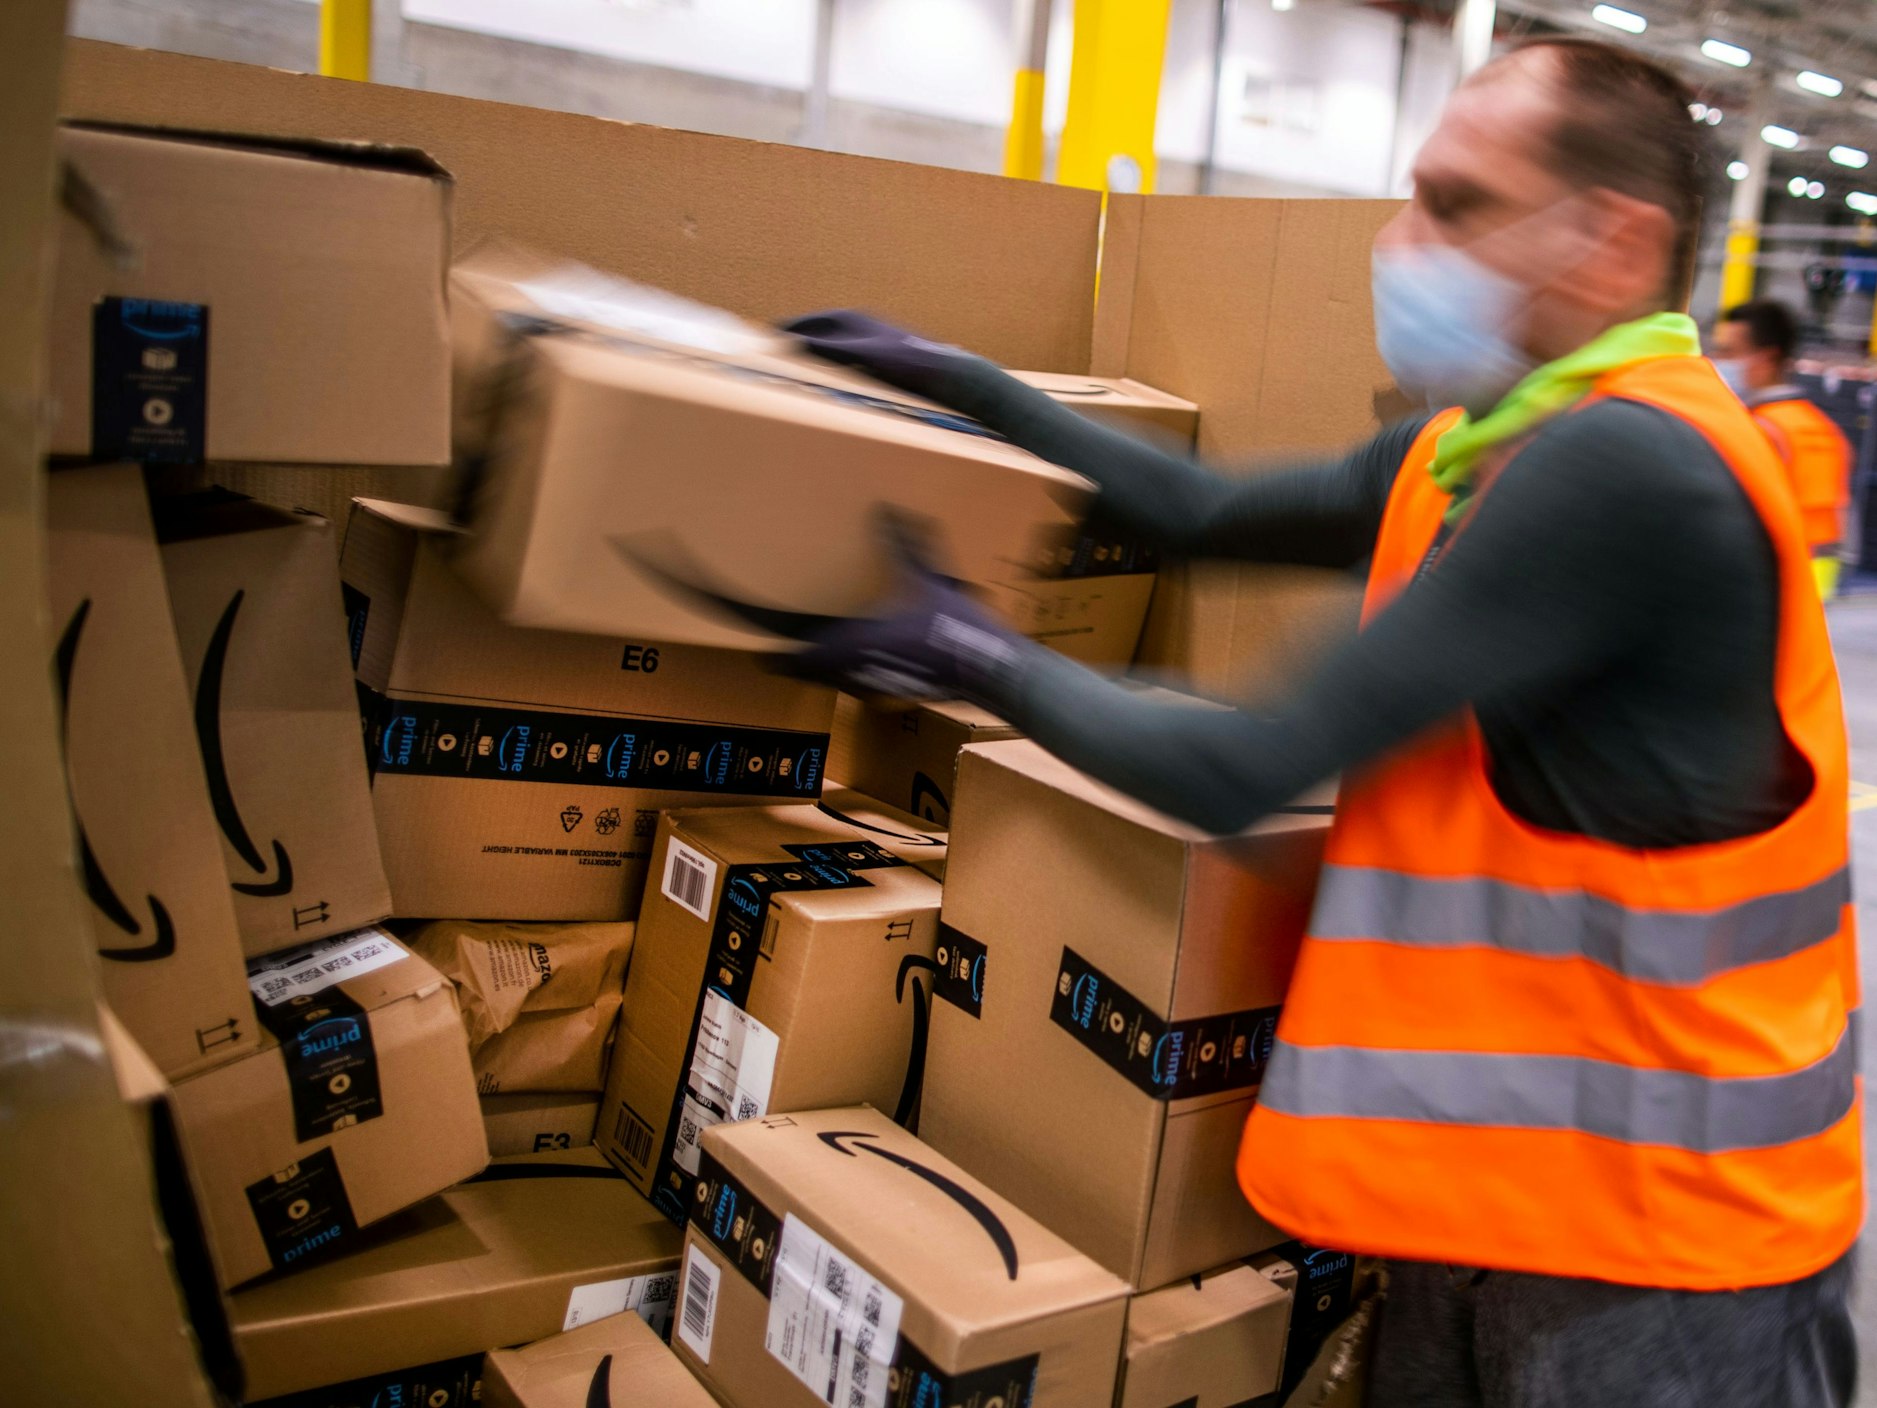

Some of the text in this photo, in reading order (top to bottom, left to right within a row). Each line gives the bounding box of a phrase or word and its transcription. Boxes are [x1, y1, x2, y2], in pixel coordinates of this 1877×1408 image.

[621, 645, 660, 673] E6
[397, 716, 418, 765] prime
[511, 725, 531, 772] prime
[617, 733, 636, 779] prime
[715, 741, 732, 785] prime
[804, 748, 821, 790] prime
[482, 845, 513, 854] HEIGHT
[513, 846, 554, 855] VARIABLE
[727, 888, 760, 917] prime
[1080, 974, 1099, 1029] prime
[301, 1022, 361, 1058] prime
[1164, 1031, 1184, 1086] prime
[713, 1183, 730, 1240] prime
[283, 1224, 342, 1263] prime
[1309, 1252, 1348, 1279] prime
